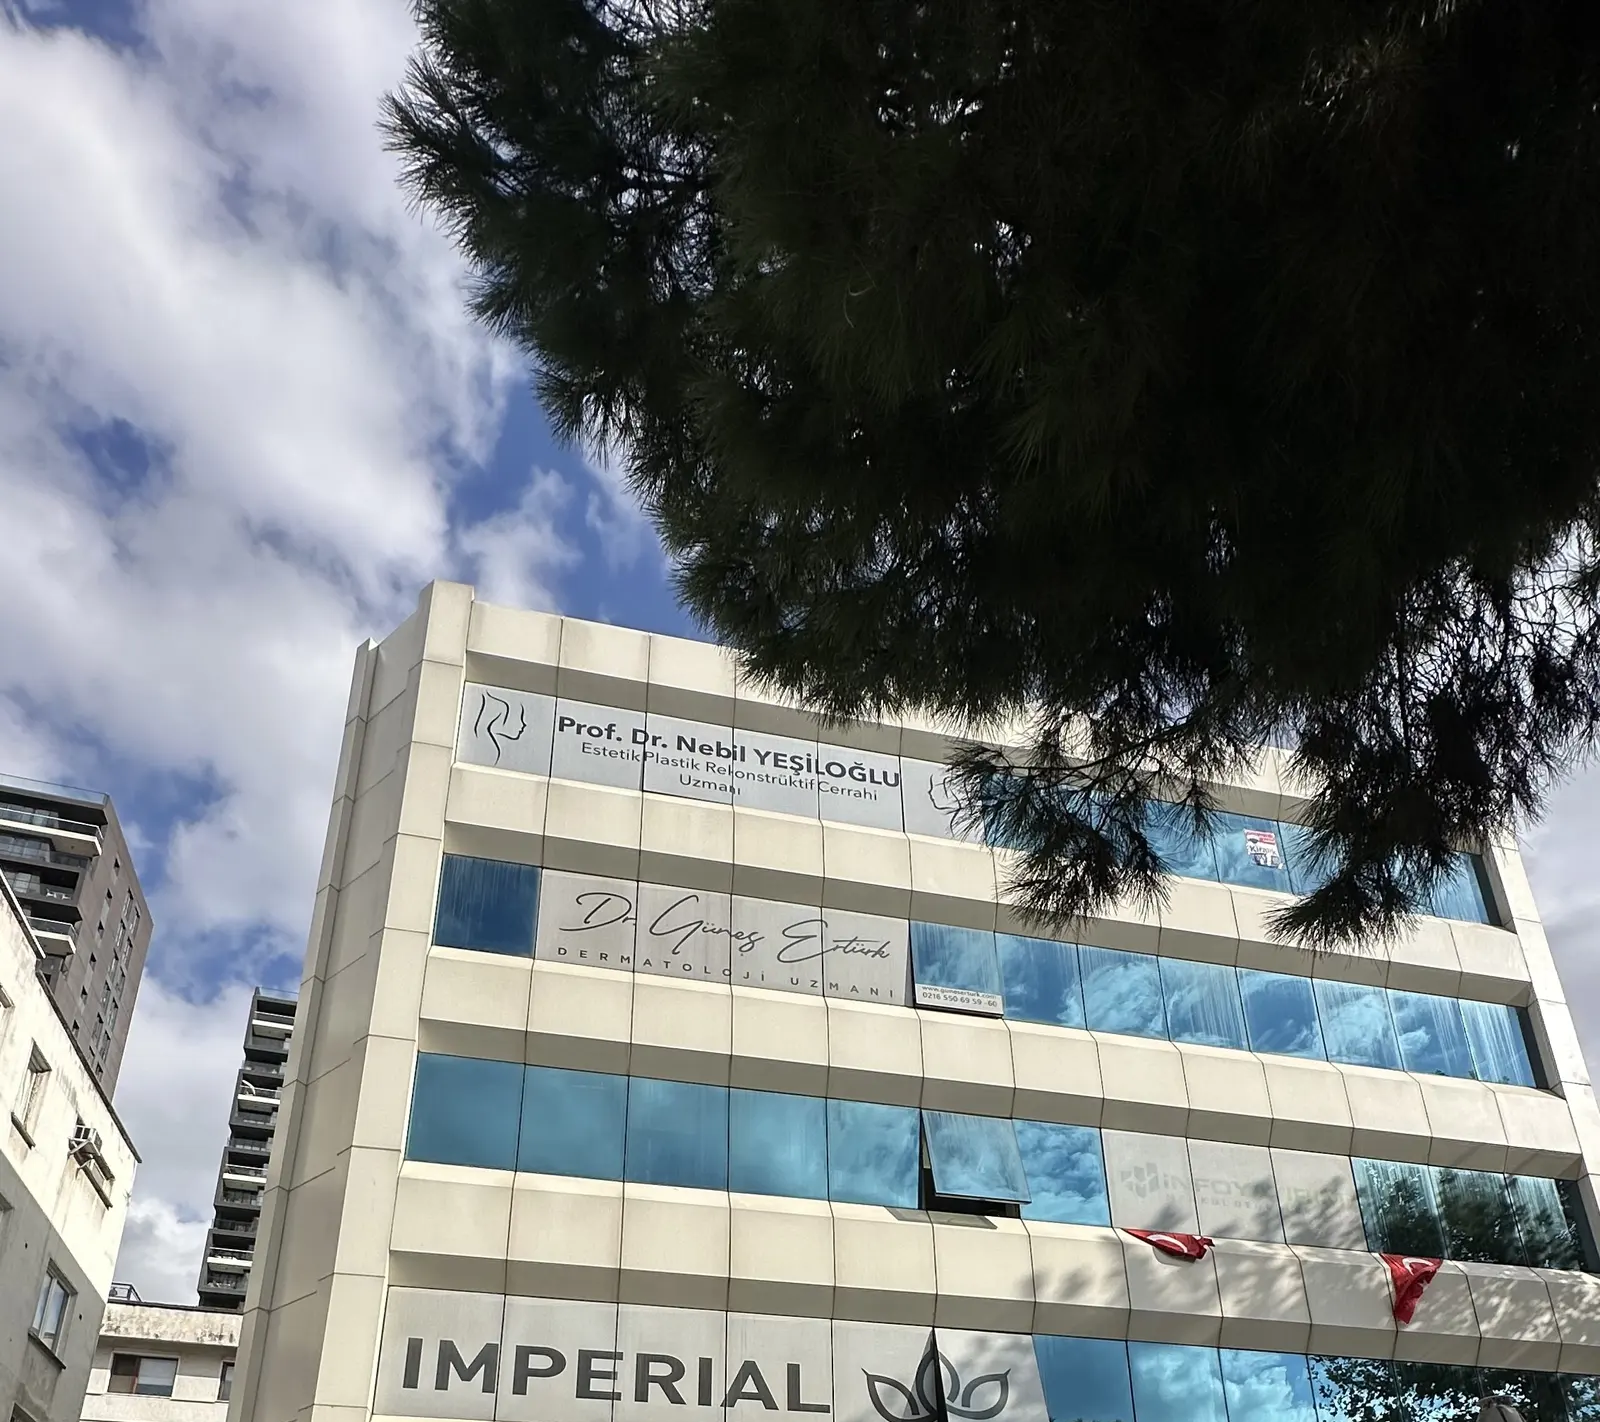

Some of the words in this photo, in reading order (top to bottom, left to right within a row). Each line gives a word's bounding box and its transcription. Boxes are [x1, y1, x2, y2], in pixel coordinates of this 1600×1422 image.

[558, 715, 622, 745] Prof.
[632, 727, 668, 750] Dr.
[676, 733, 746, 763] Nebil
[753, 745, 900, 789] YEŞİLOĞLU
[581, 741, 641, 763] Estetik
[645, 750, 700, 772] Plastik
[705, 760, 816, 791] Rekonstrüktif
[818, 781, 878, 802] Cerrahi
[679, 773, 742, 796] Uzmanı
[557, 946, 766, 983] DERMATOLOJİ
[790, 976, 895, 1000] UZMANI
[922, 992, 941, 1001] 0216
[943, 995, 958, 1003] 550
[960, 996, 970, 1004] 69
[972, 998, 982, 1006] 59
[401, 1337, 831, 1415] IMPERIAL
